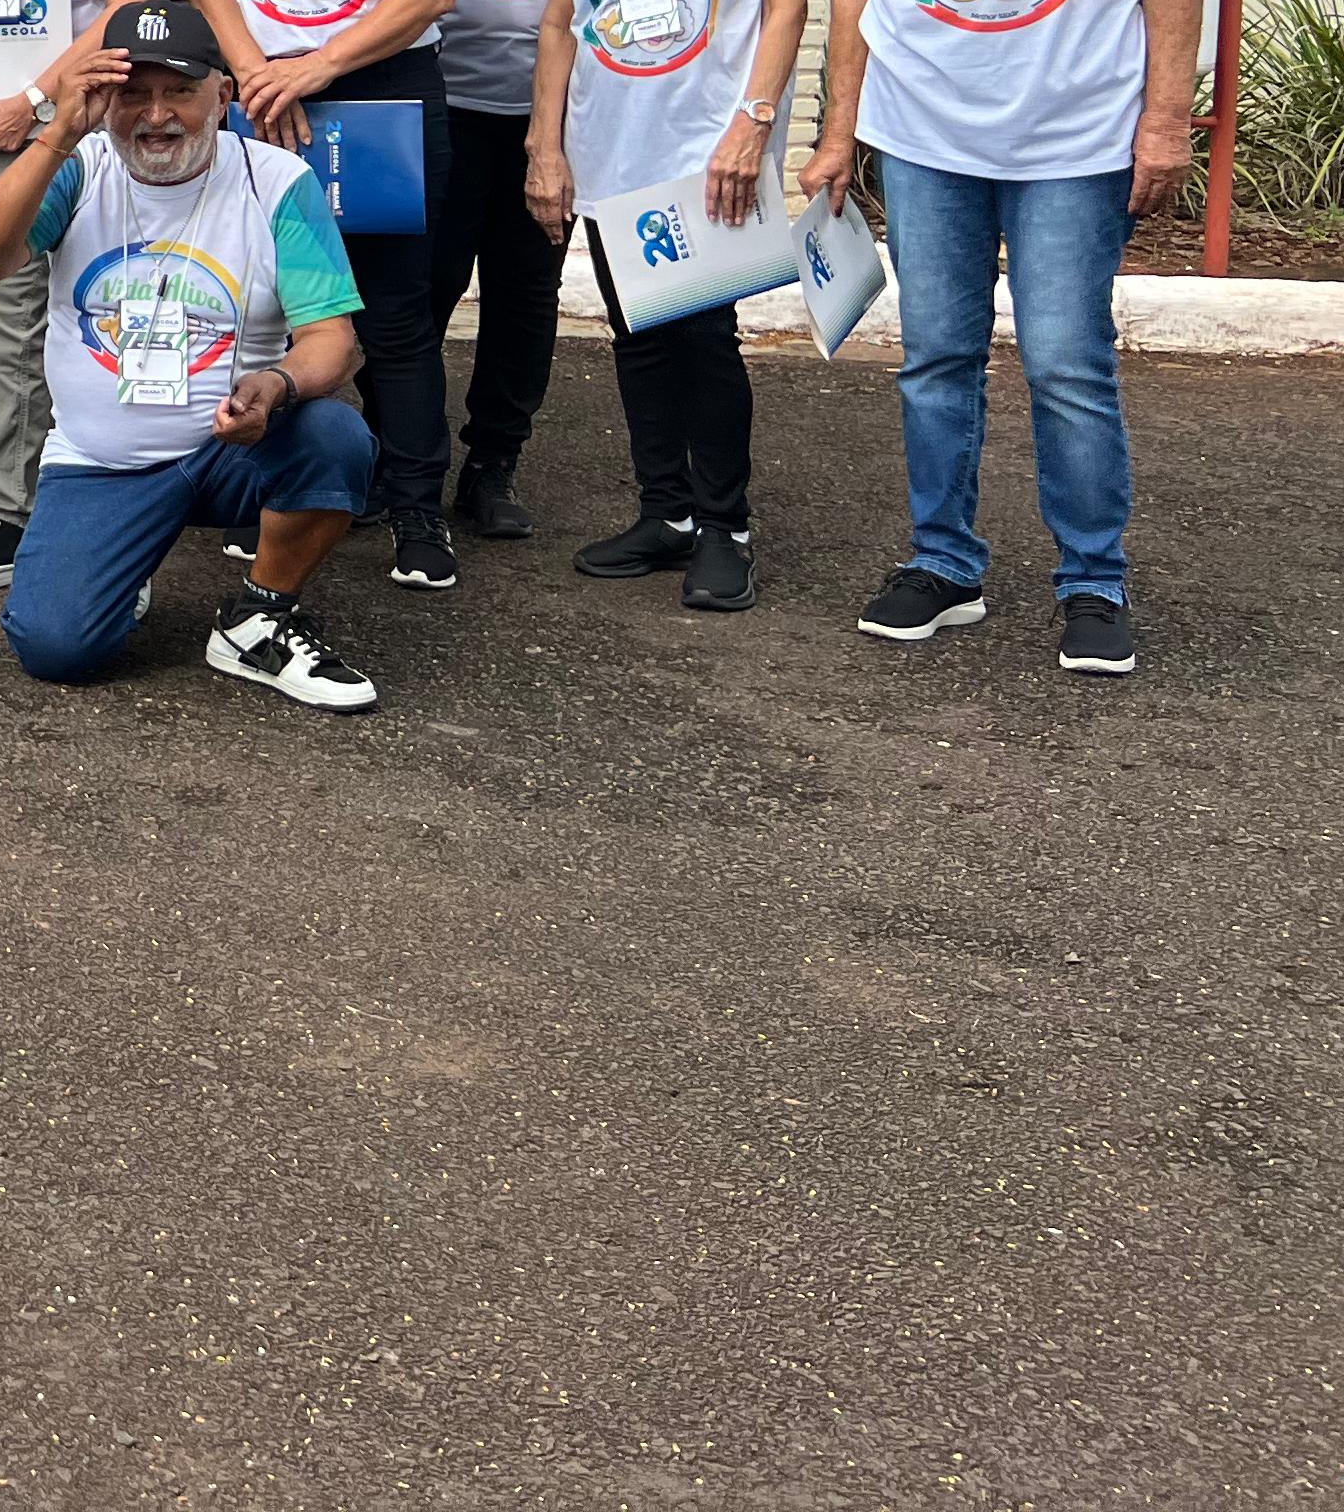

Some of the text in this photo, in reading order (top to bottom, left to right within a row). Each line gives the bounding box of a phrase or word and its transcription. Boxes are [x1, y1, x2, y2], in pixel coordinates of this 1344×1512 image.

[635, 210, 680, 268] 20
[667, 203, 690, 260] ESCOLA
[96, 273, 225, 314] Vida Ativa
